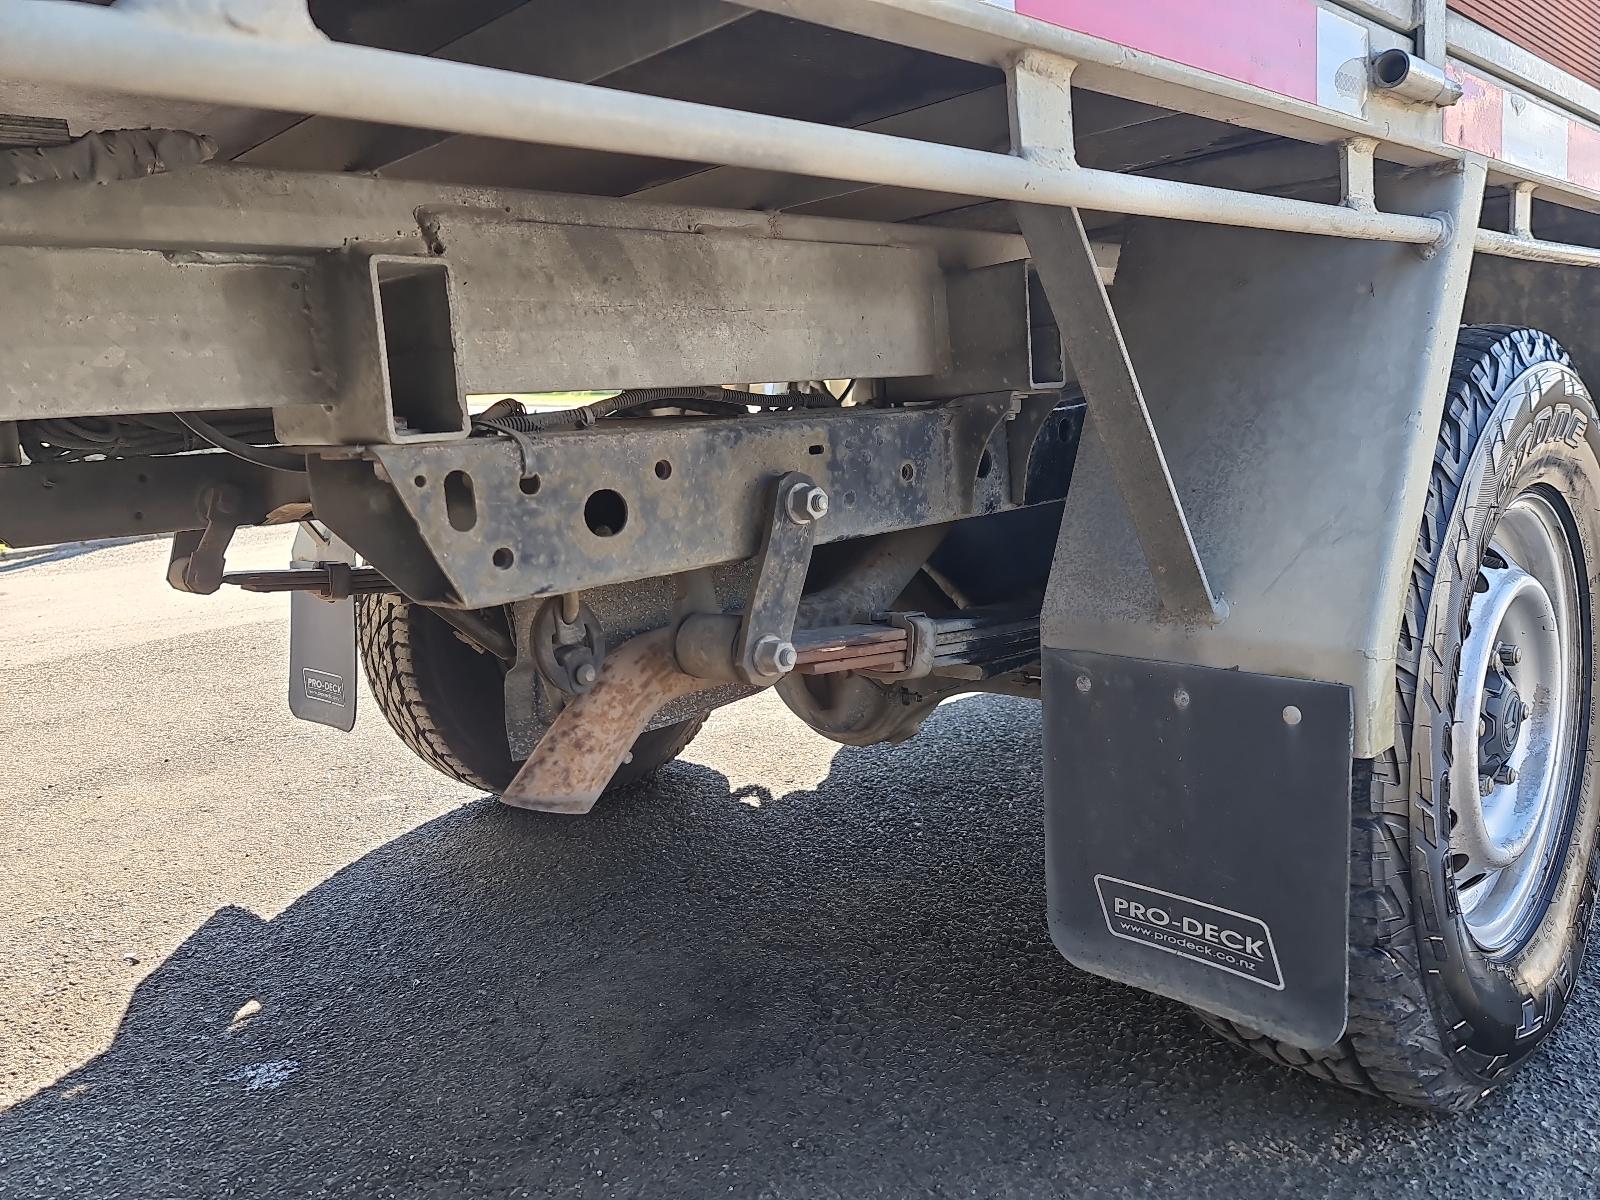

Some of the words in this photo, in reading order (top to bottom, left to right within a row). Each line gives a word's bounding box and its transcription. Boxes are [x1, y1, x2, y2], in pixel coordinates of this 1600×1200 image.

[307, 677, 342, 694] PRO-DECK
[1114, 896, 1265, 959] PRO-DECK
[1120, 920, 1257, 972] www.prodeck.co.nz
